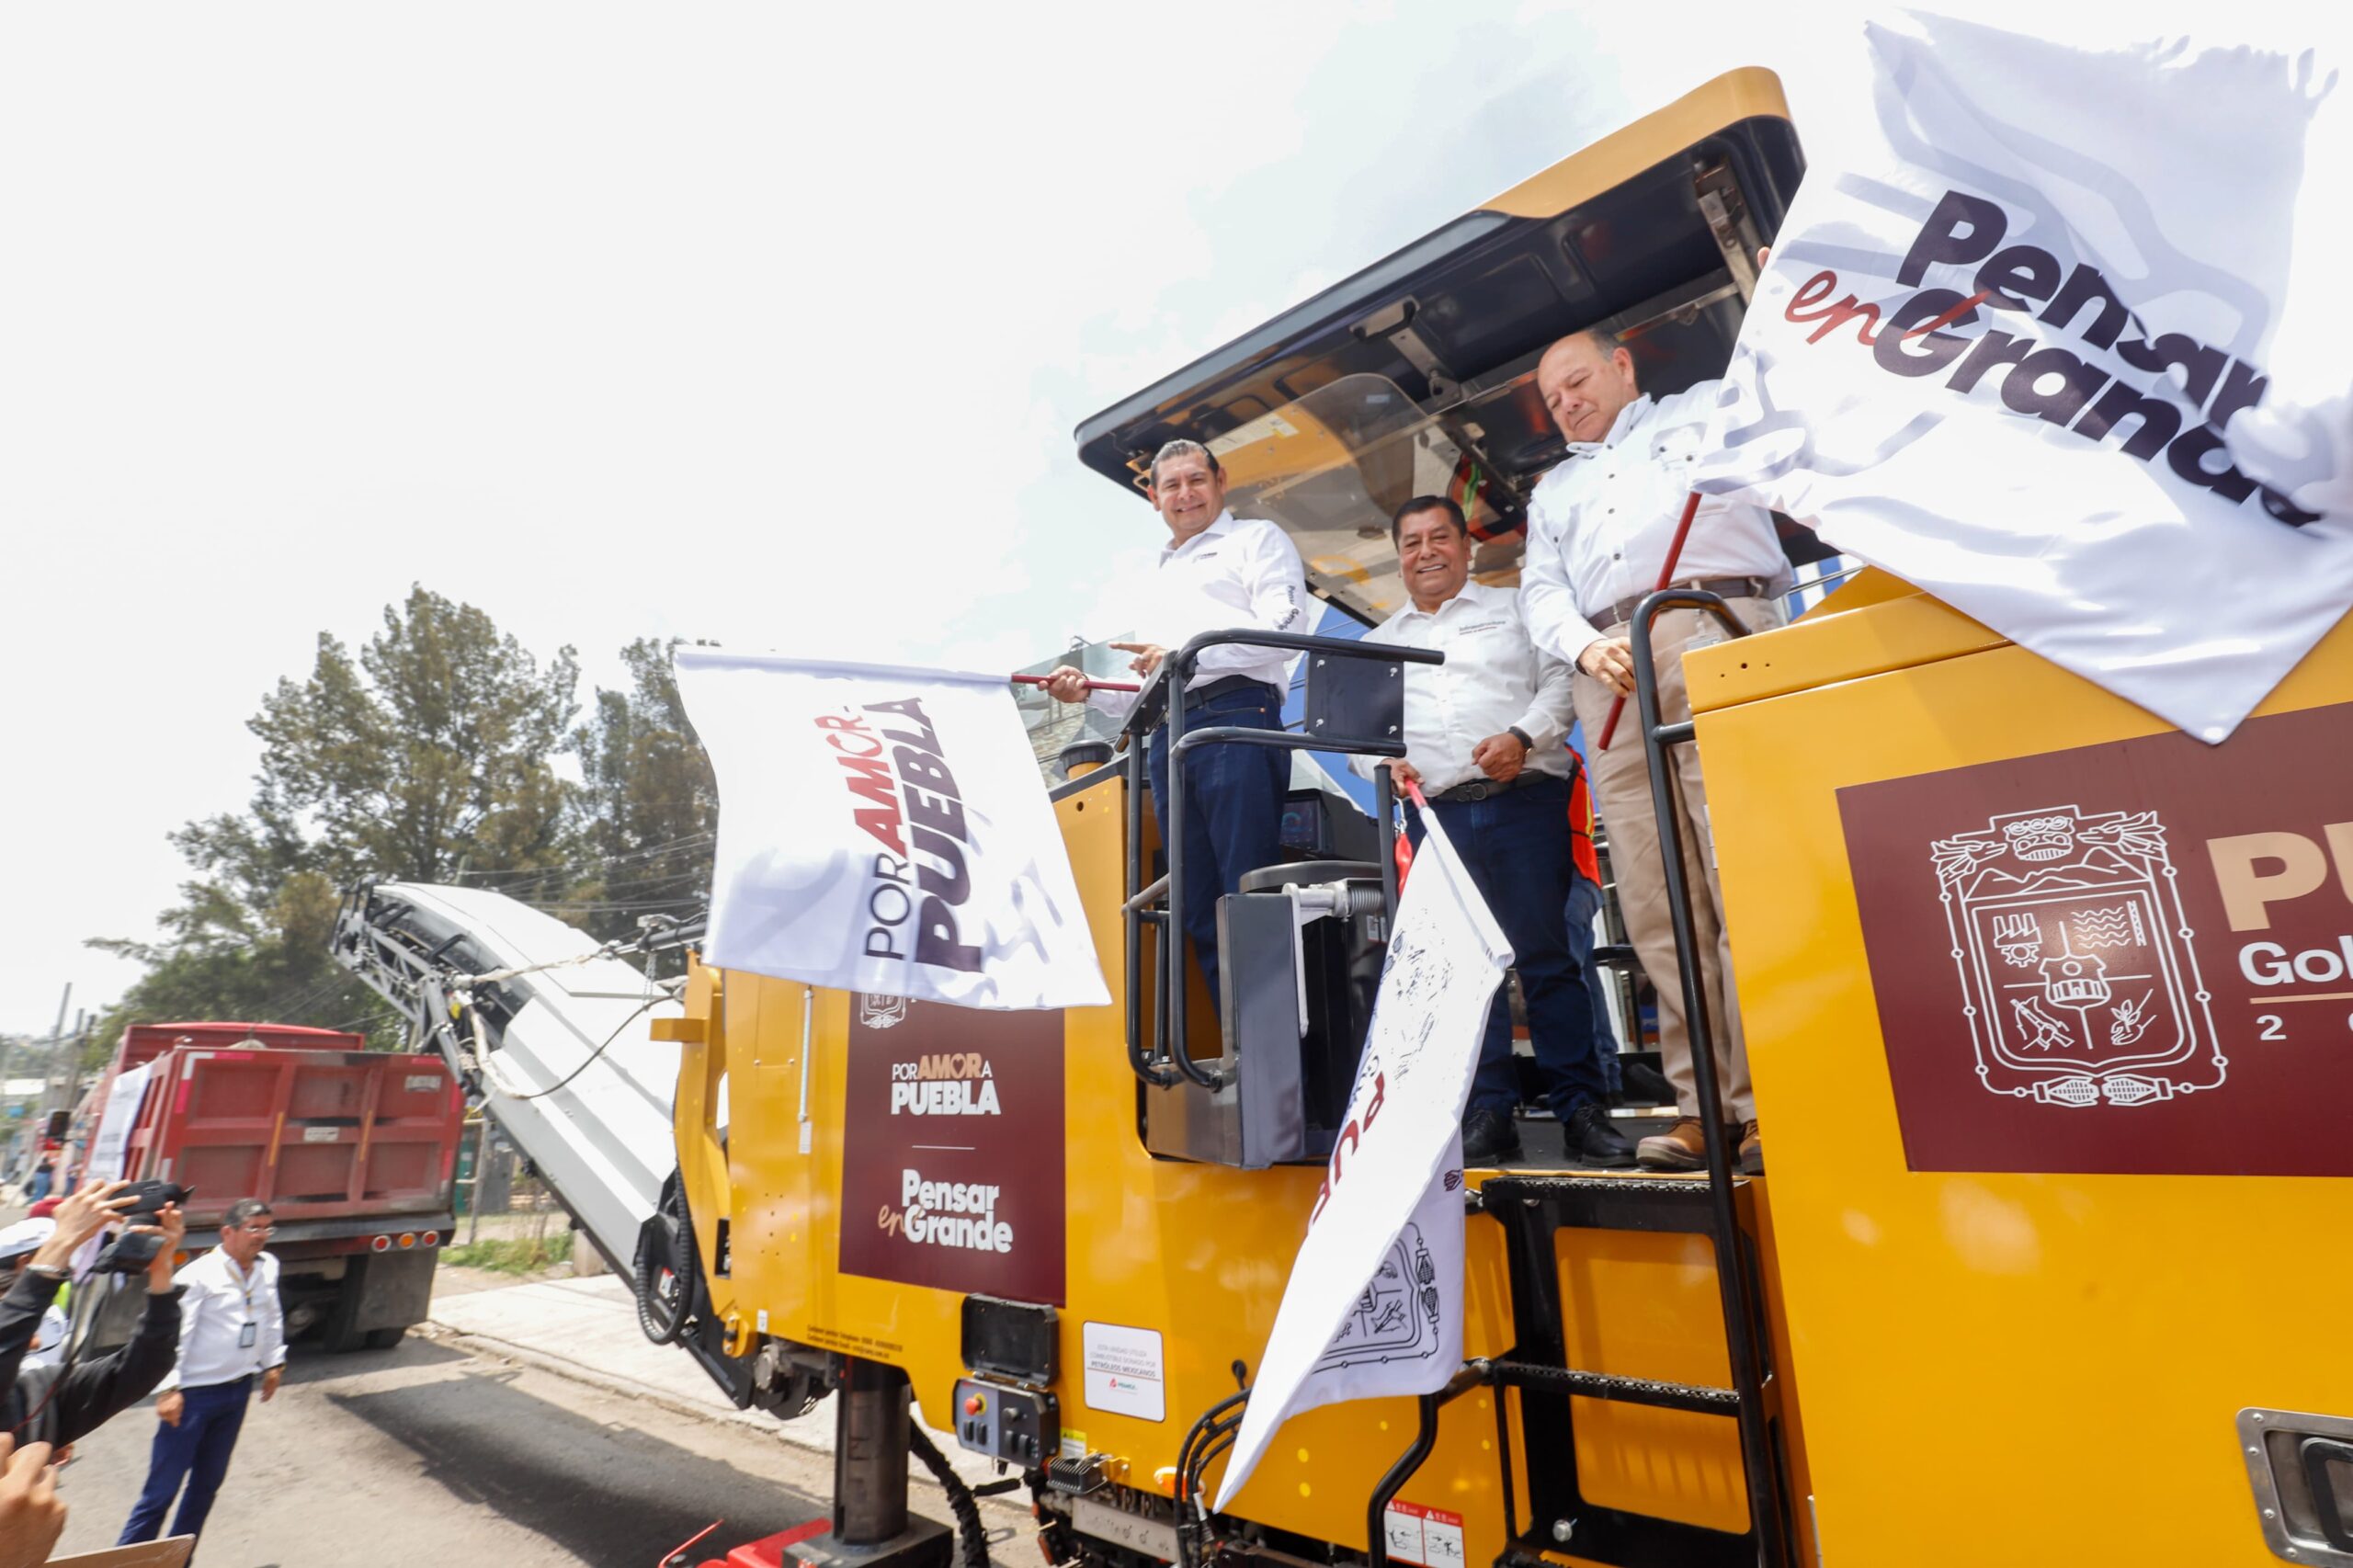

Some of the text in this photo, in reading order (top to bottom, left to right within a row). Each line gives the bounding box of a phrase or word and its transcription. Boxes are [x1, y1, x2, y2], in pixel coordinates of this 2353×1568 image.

[1785, 270, 1907, 346] en
[813, 715, 913, 960] POR AMOR
[861, 697, 984, 973] PUEBLA
[892, 1052, 993, 1081] POR AMOR A
[890, 1079, 1002, 1116] PUEBLA
[902, 1168, 1000, 1214] Pensar
[878, 1203, 1014, 1254] en Grande
